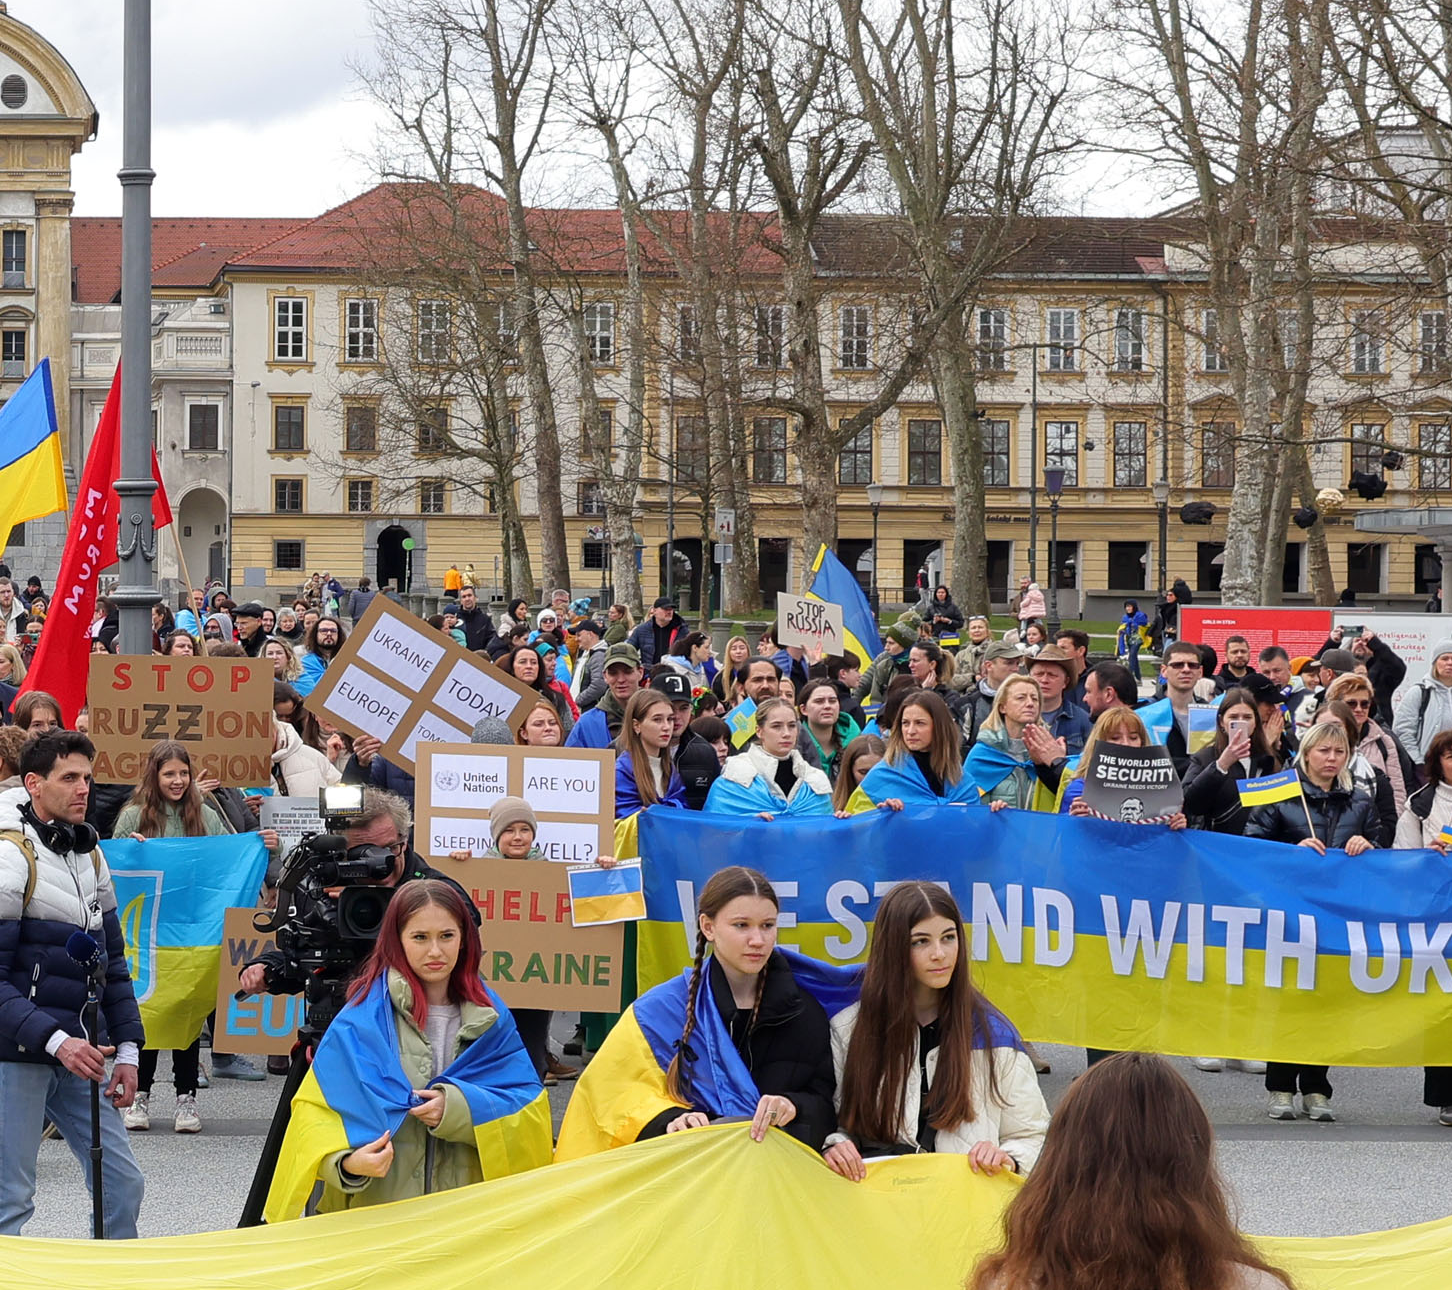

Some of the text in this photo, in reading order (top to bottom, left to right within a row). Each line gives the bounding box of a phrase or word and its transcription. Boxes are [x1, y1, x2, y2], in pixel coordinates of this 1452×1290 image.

[796, 600, 826, 619] STOP
[787, 612, 836, 638] RUSSIA
[373, 628, 434, 674] UKRAINE
[112, 662, 251, 693] STOP
[337, 681, 400, 726] EUROPE
[447, 678, 506, 717] TODAY
[92, 703, 270, 741] RUZZION
[93, 751, 271, 782] AGSION
[1095, 764, 1173, 783] SECURITY
[1099, 754, 1117, 765] THE
[1118, 757, 1151, 767] WORLD
[463, 772, 498, 783] United
[463, 783, 505, 794] Nations
[527, 776, 596, 793] ARE YOU
[1103, 781, 1128, 789] UKRAINE
[434, 835, 497, 850] SLEEPIN
[471, 888, 572, 923] HELP
[824, 879, 1075, 968] SND
[1099, 894, 1318, 991] WITH
[478, 950, 611, 987] RAINE
